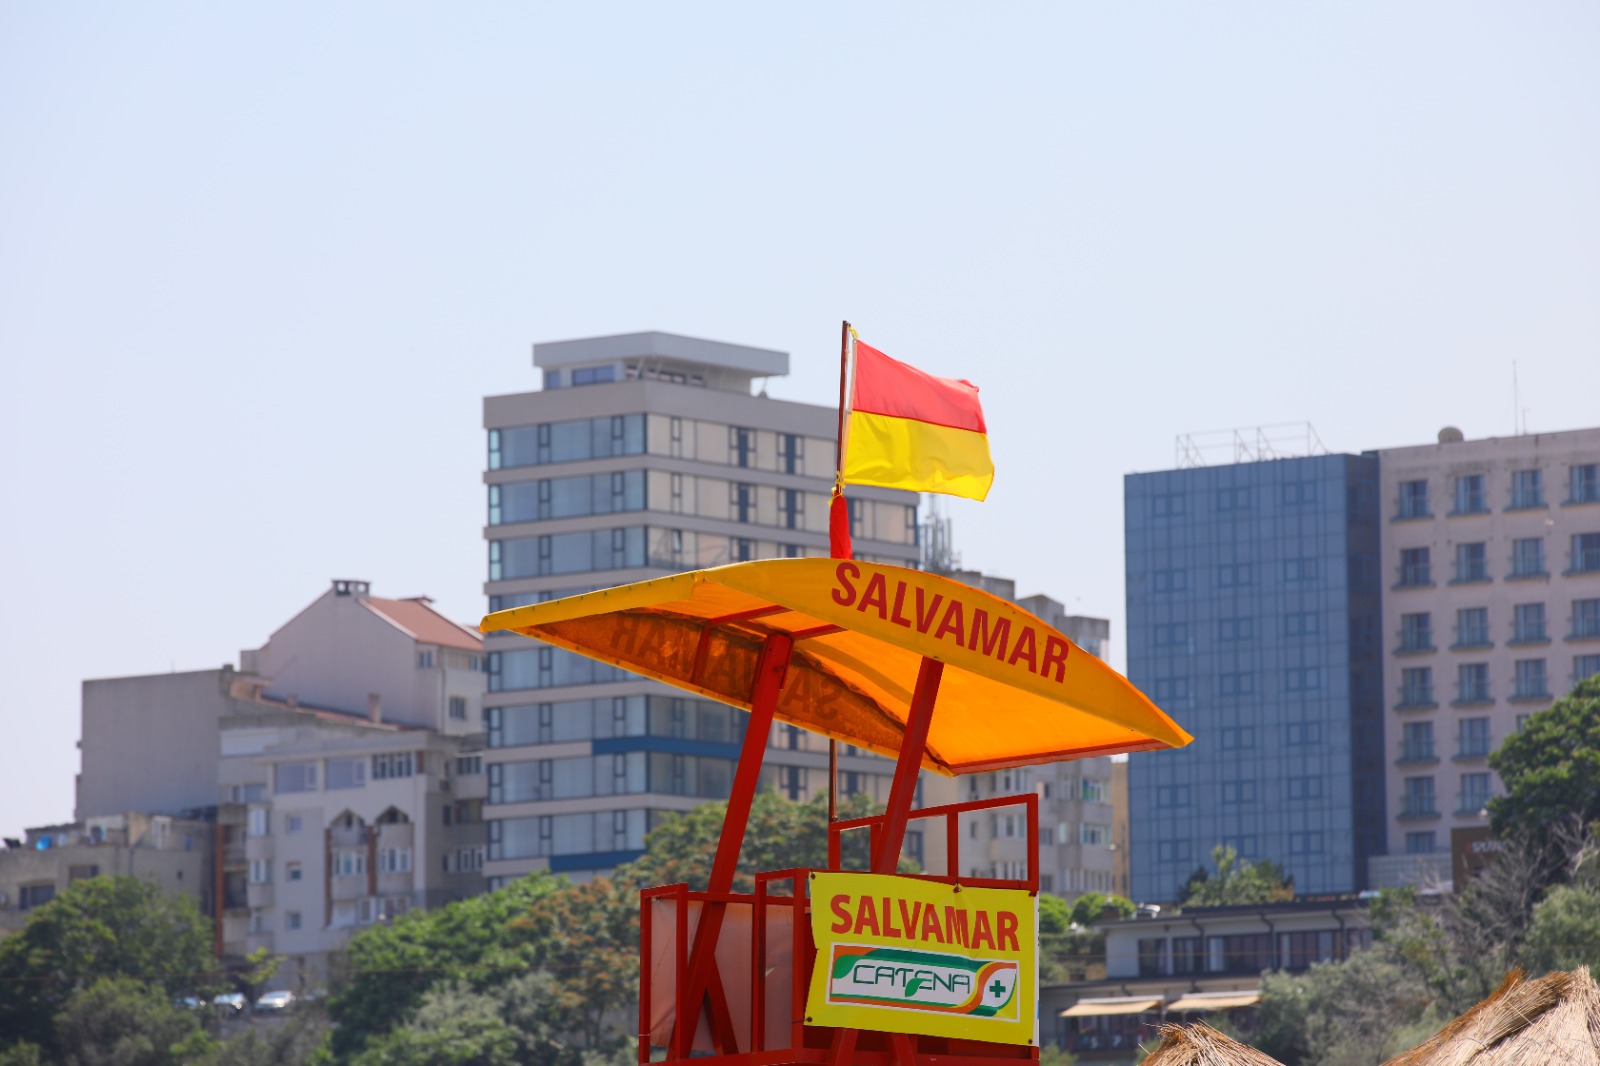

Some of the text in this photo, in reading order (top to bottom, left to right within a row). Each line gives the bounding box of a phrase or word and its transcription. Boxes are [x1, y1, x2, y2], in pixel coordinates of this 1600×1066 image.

[831, 561, 1070, 684] SALVAMAR
[830, 894, 1020, 952] SALVAMAR
[853, 964, 970, 998] CATENA
